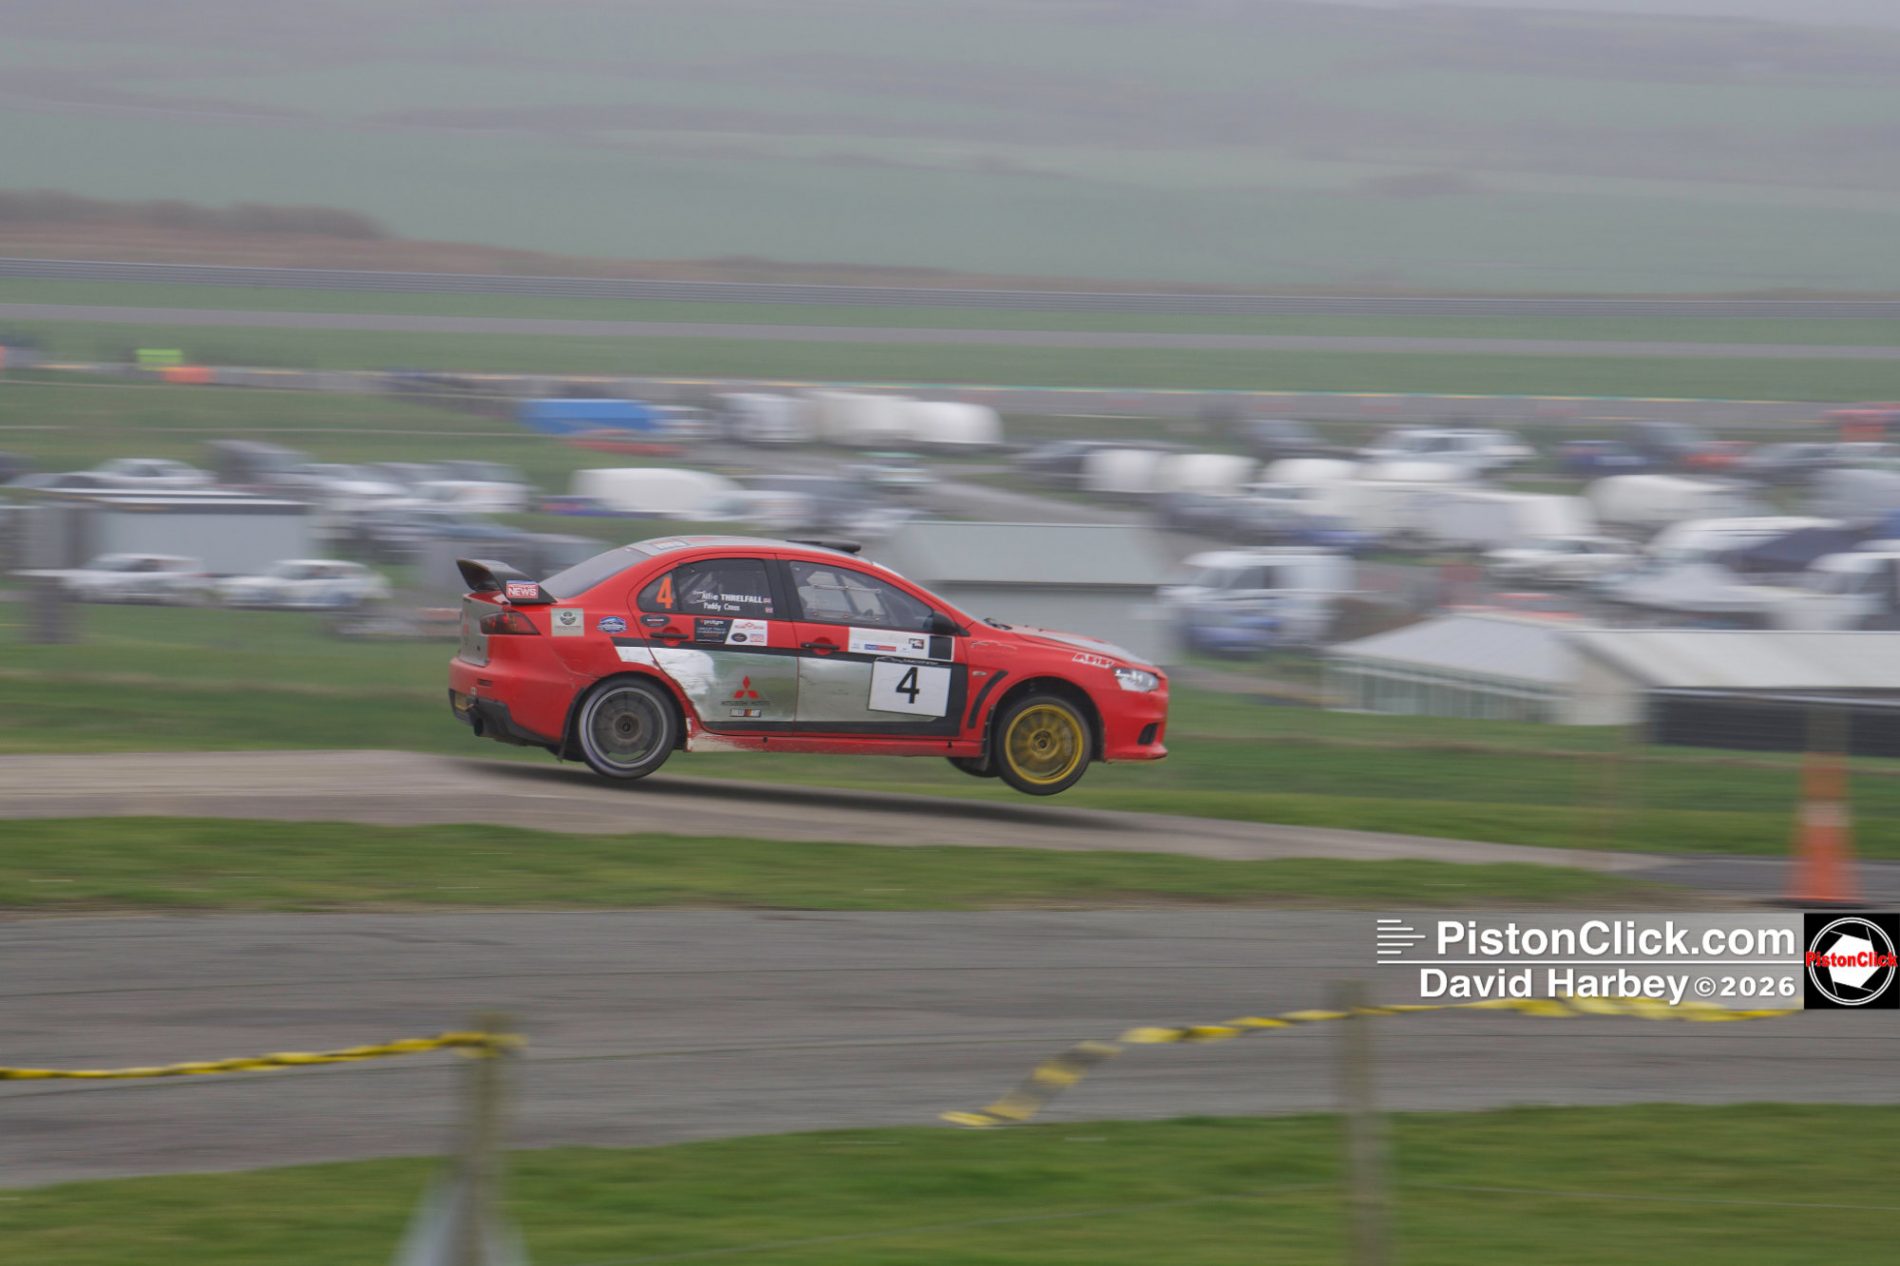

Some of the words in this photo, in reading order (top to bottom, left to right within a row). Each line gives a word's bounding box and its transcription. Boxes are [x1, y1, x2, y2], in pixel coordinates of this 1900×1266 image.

[507, 587, 537, 597] NEWS
[655, 577, 674, 609] 4
[721, 593, 764, 603] THRELFALL
[896, 667, 920, 704] 4
